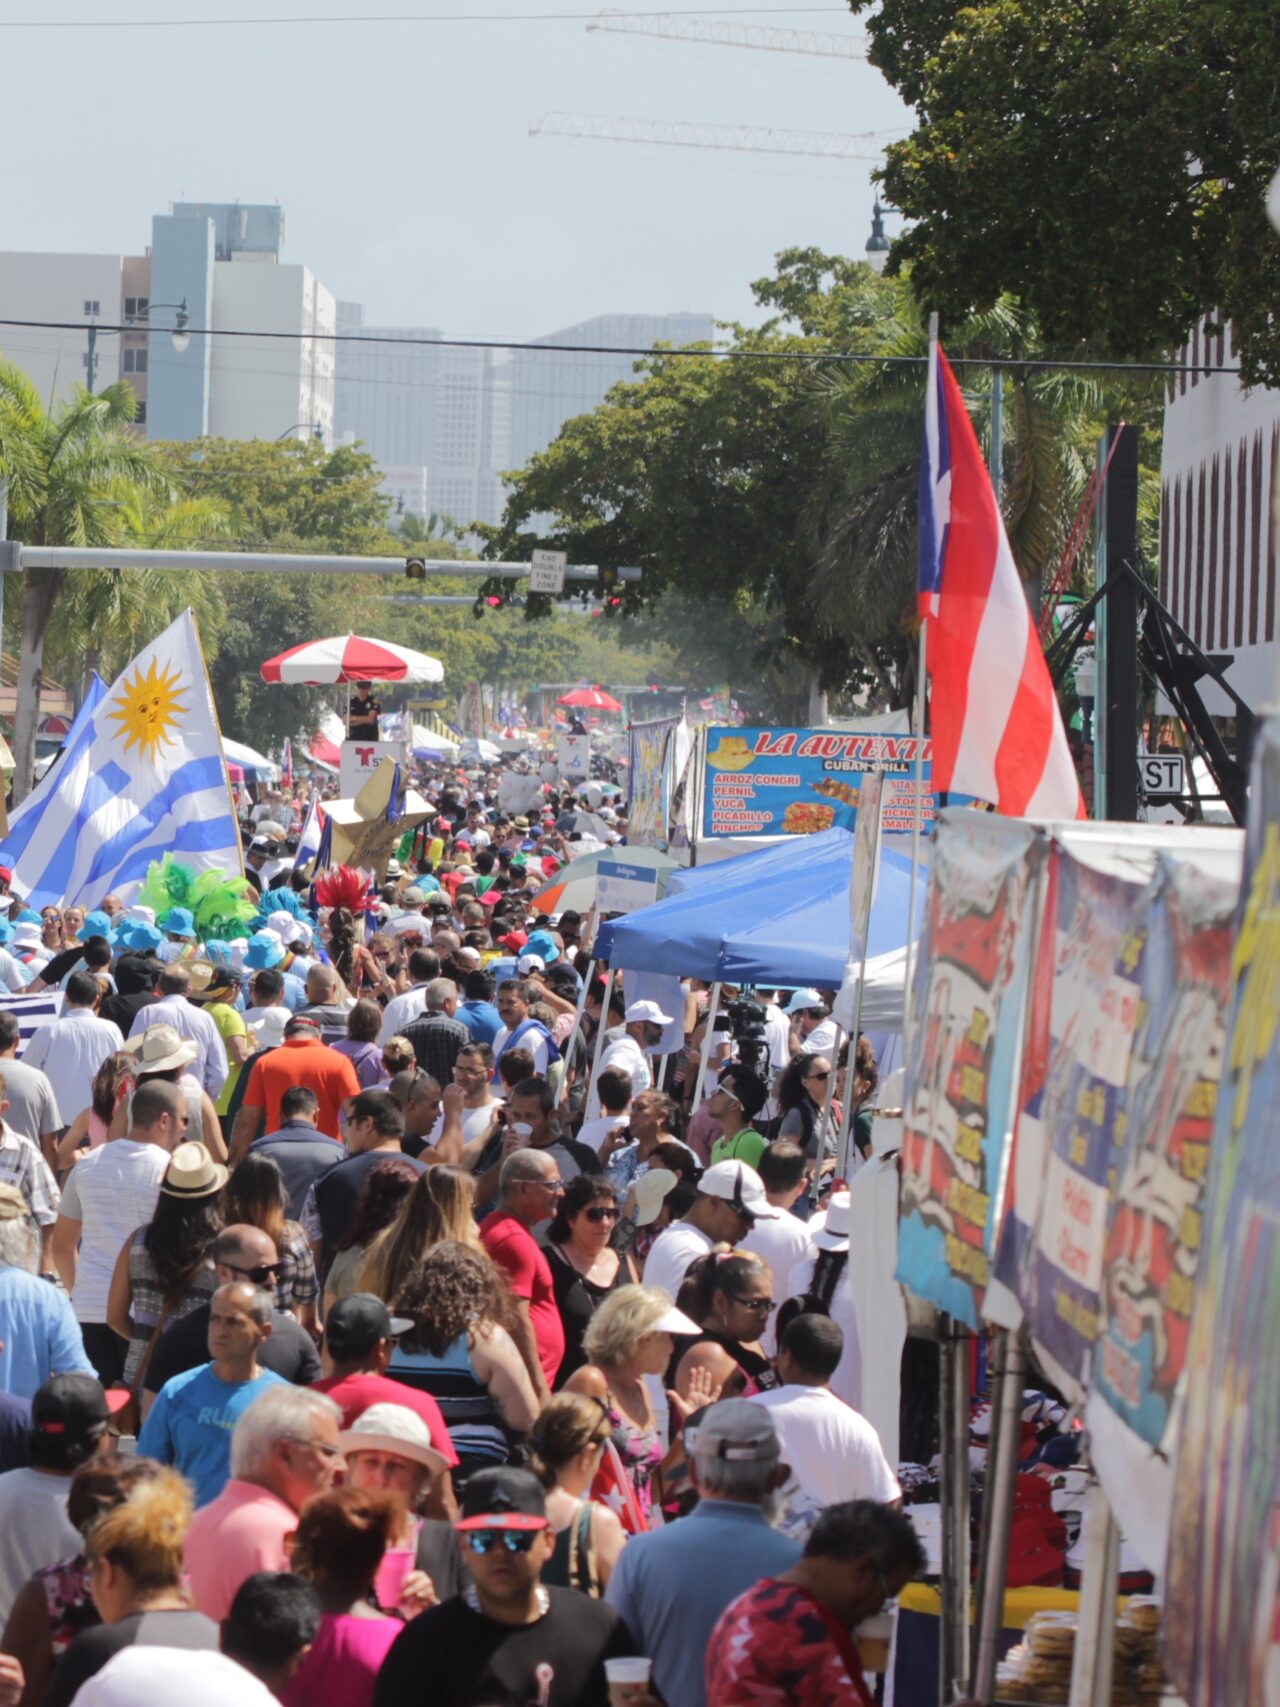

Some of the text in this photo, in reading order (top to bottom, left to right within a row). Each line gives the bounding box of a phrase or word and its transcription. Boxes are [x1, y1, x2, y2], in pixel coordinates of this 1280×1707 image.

[541, 554, 557, 562] END
[533, 562, 563, 571] DOUBLE
[536, 572, 558, 580] FINES
[536, 581, 556, 589] ZONE
[753, 732, 797, 756] LA
[824, 760, 909, 772] CUBAN GRILL
[714, 773, 800, 786] ARROZ CONGRI
[1145, 761, 1180, 789] ST
[713, 785, 756, 798] PERNIL
[712, 797, 746, 810] YUCA
[887, 797, 934, 807] STONES
[712, 810, 773, 823] PICADILLO
